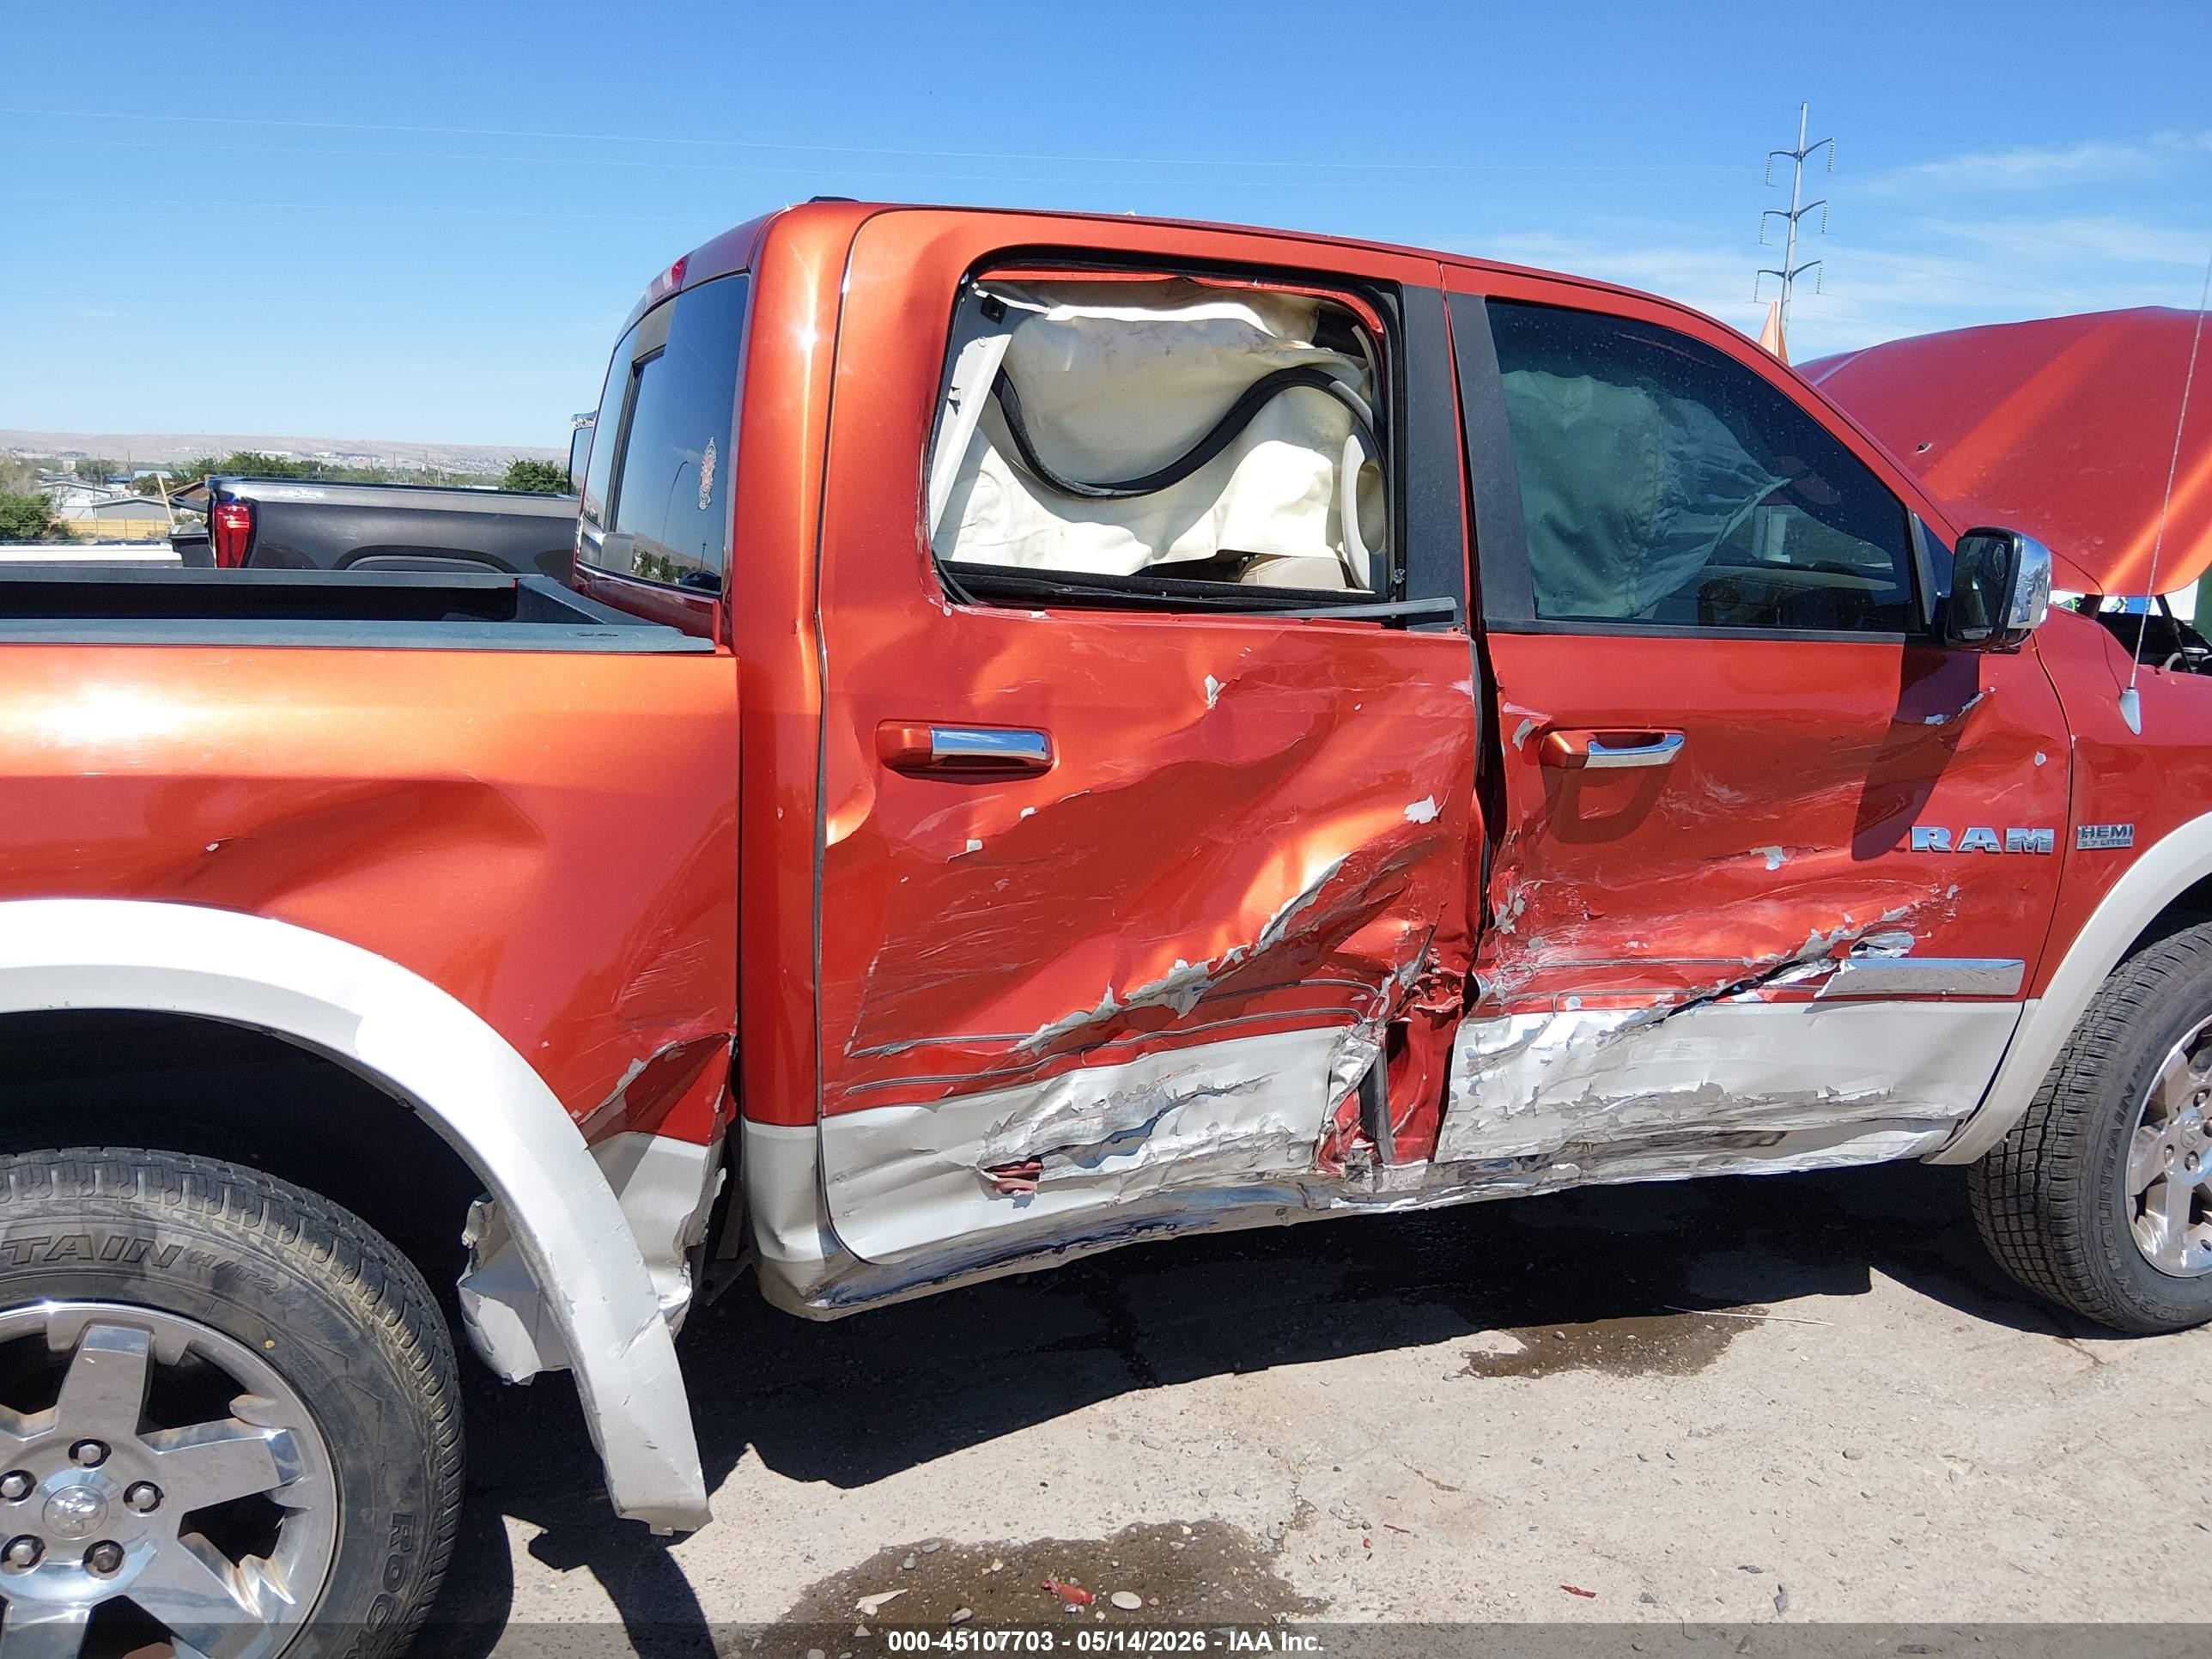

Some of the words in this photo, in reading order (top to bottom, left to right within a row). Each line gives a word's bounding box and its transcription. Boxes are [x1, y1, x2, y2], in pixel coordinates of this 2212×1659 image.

[2080, 824, 2133, 838] HEMI
[1911, 827, 2055, 854] RAM
[2100, 838, 2130, 847] LITER
